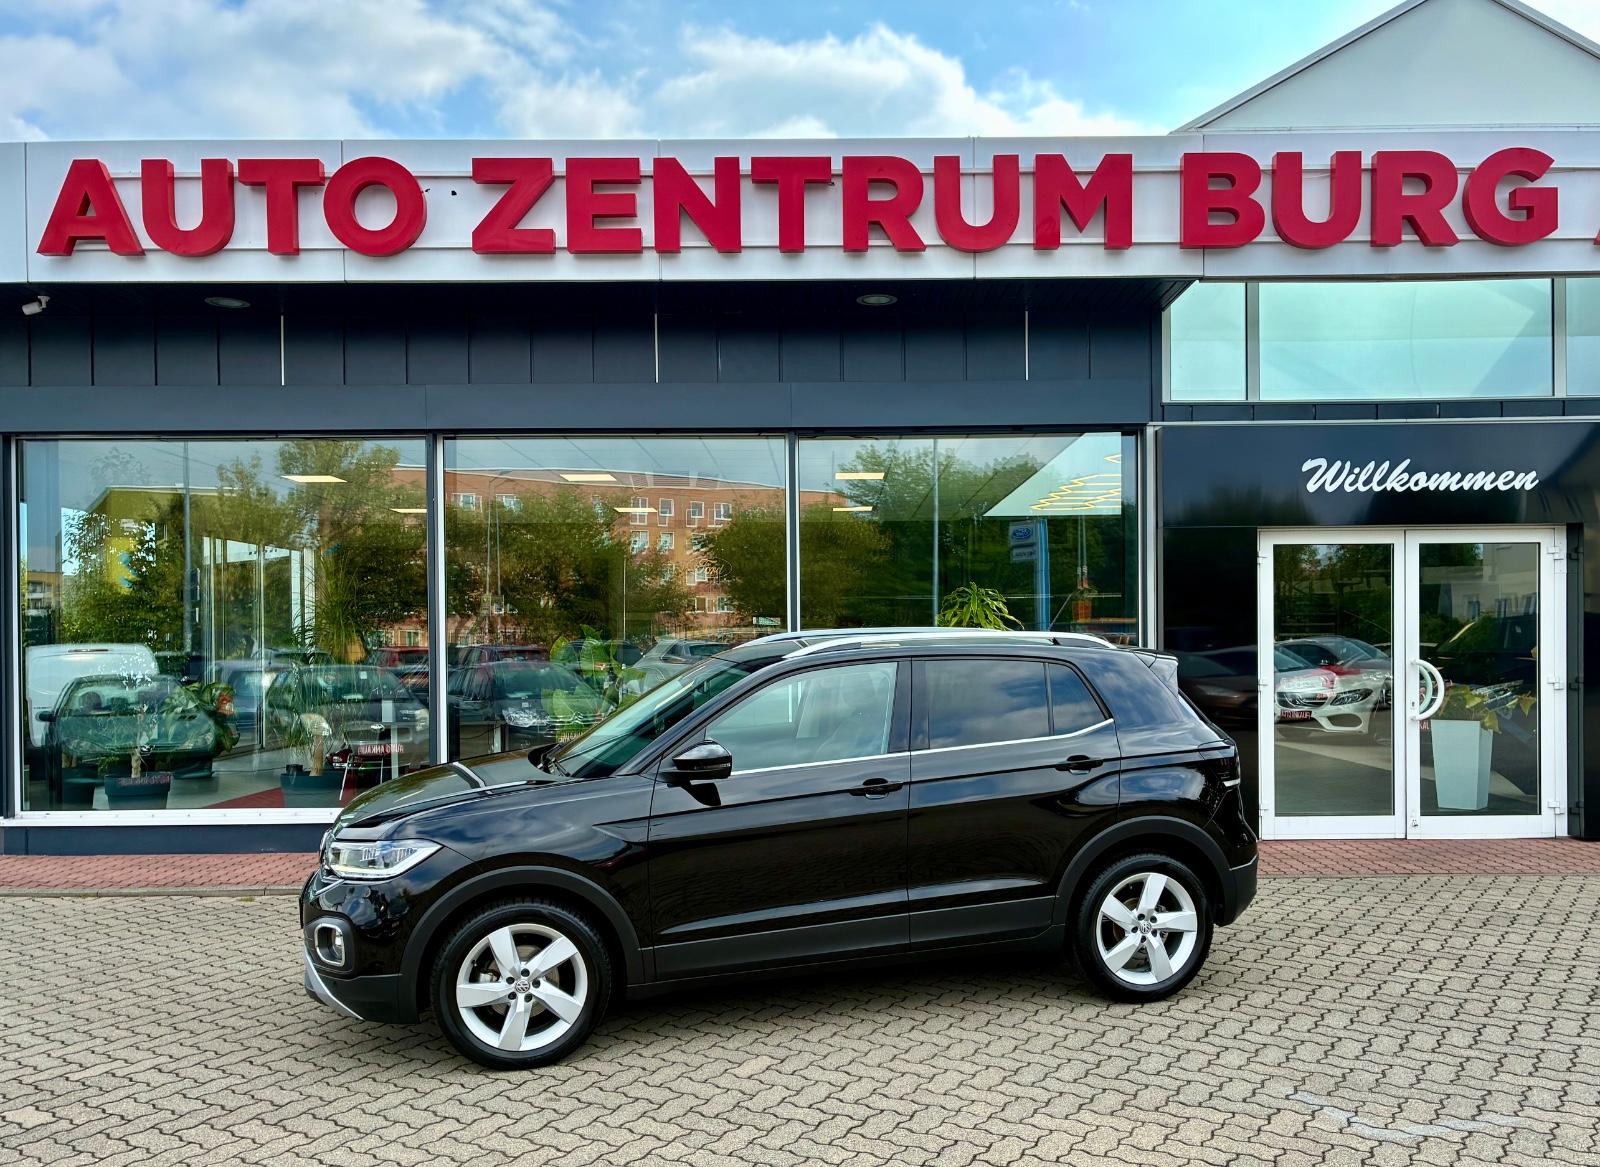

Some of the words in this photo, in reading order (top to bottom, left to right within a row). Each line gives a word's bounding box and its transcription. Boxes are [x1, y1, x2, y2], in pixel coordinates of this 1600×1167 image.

[39, 157, 426, 256] AUTO
[472, 154, 1134, 253] ZENTRUM
[1181, 148, 1559, 247] BURG
[1302, 457, 1540, 493] Willkommen
